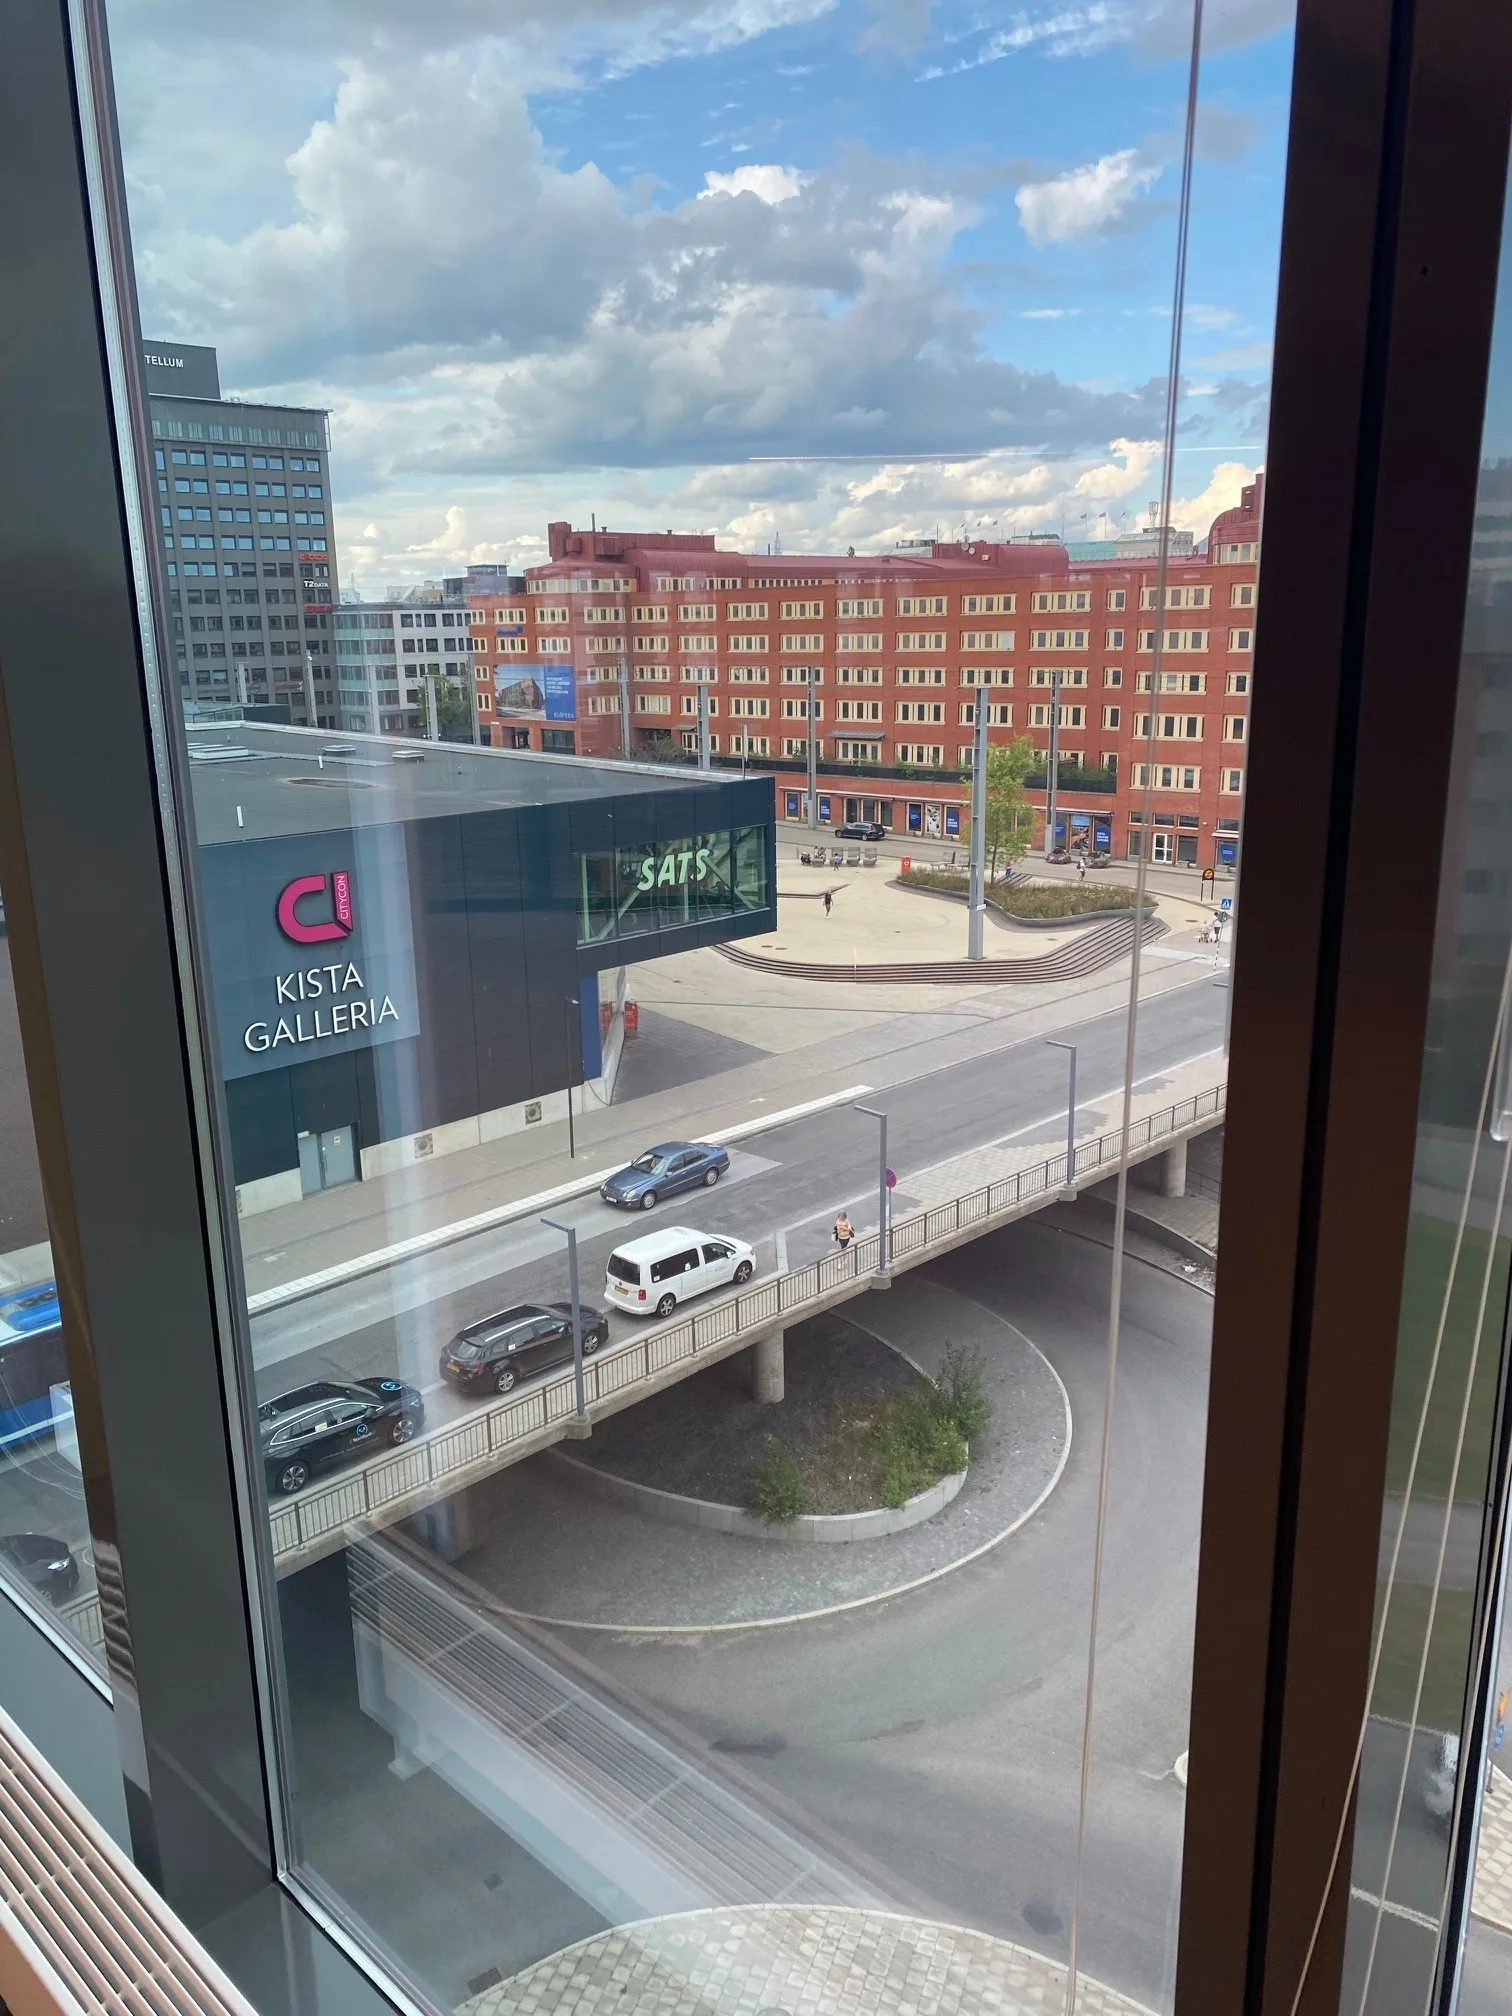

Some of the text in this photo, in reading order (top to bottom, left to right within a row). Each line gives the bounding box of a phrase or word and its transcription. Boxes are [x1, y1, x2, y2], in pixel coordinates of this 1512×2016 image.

[144, 354, 184, 368] TELLUM
[637, 848, 711, 891] SATS
[336, 875, 349, 920] CITYCON
[275, 961, 364, 1004] KISTA
[244, 994, 400, 1052] GALLERIA
